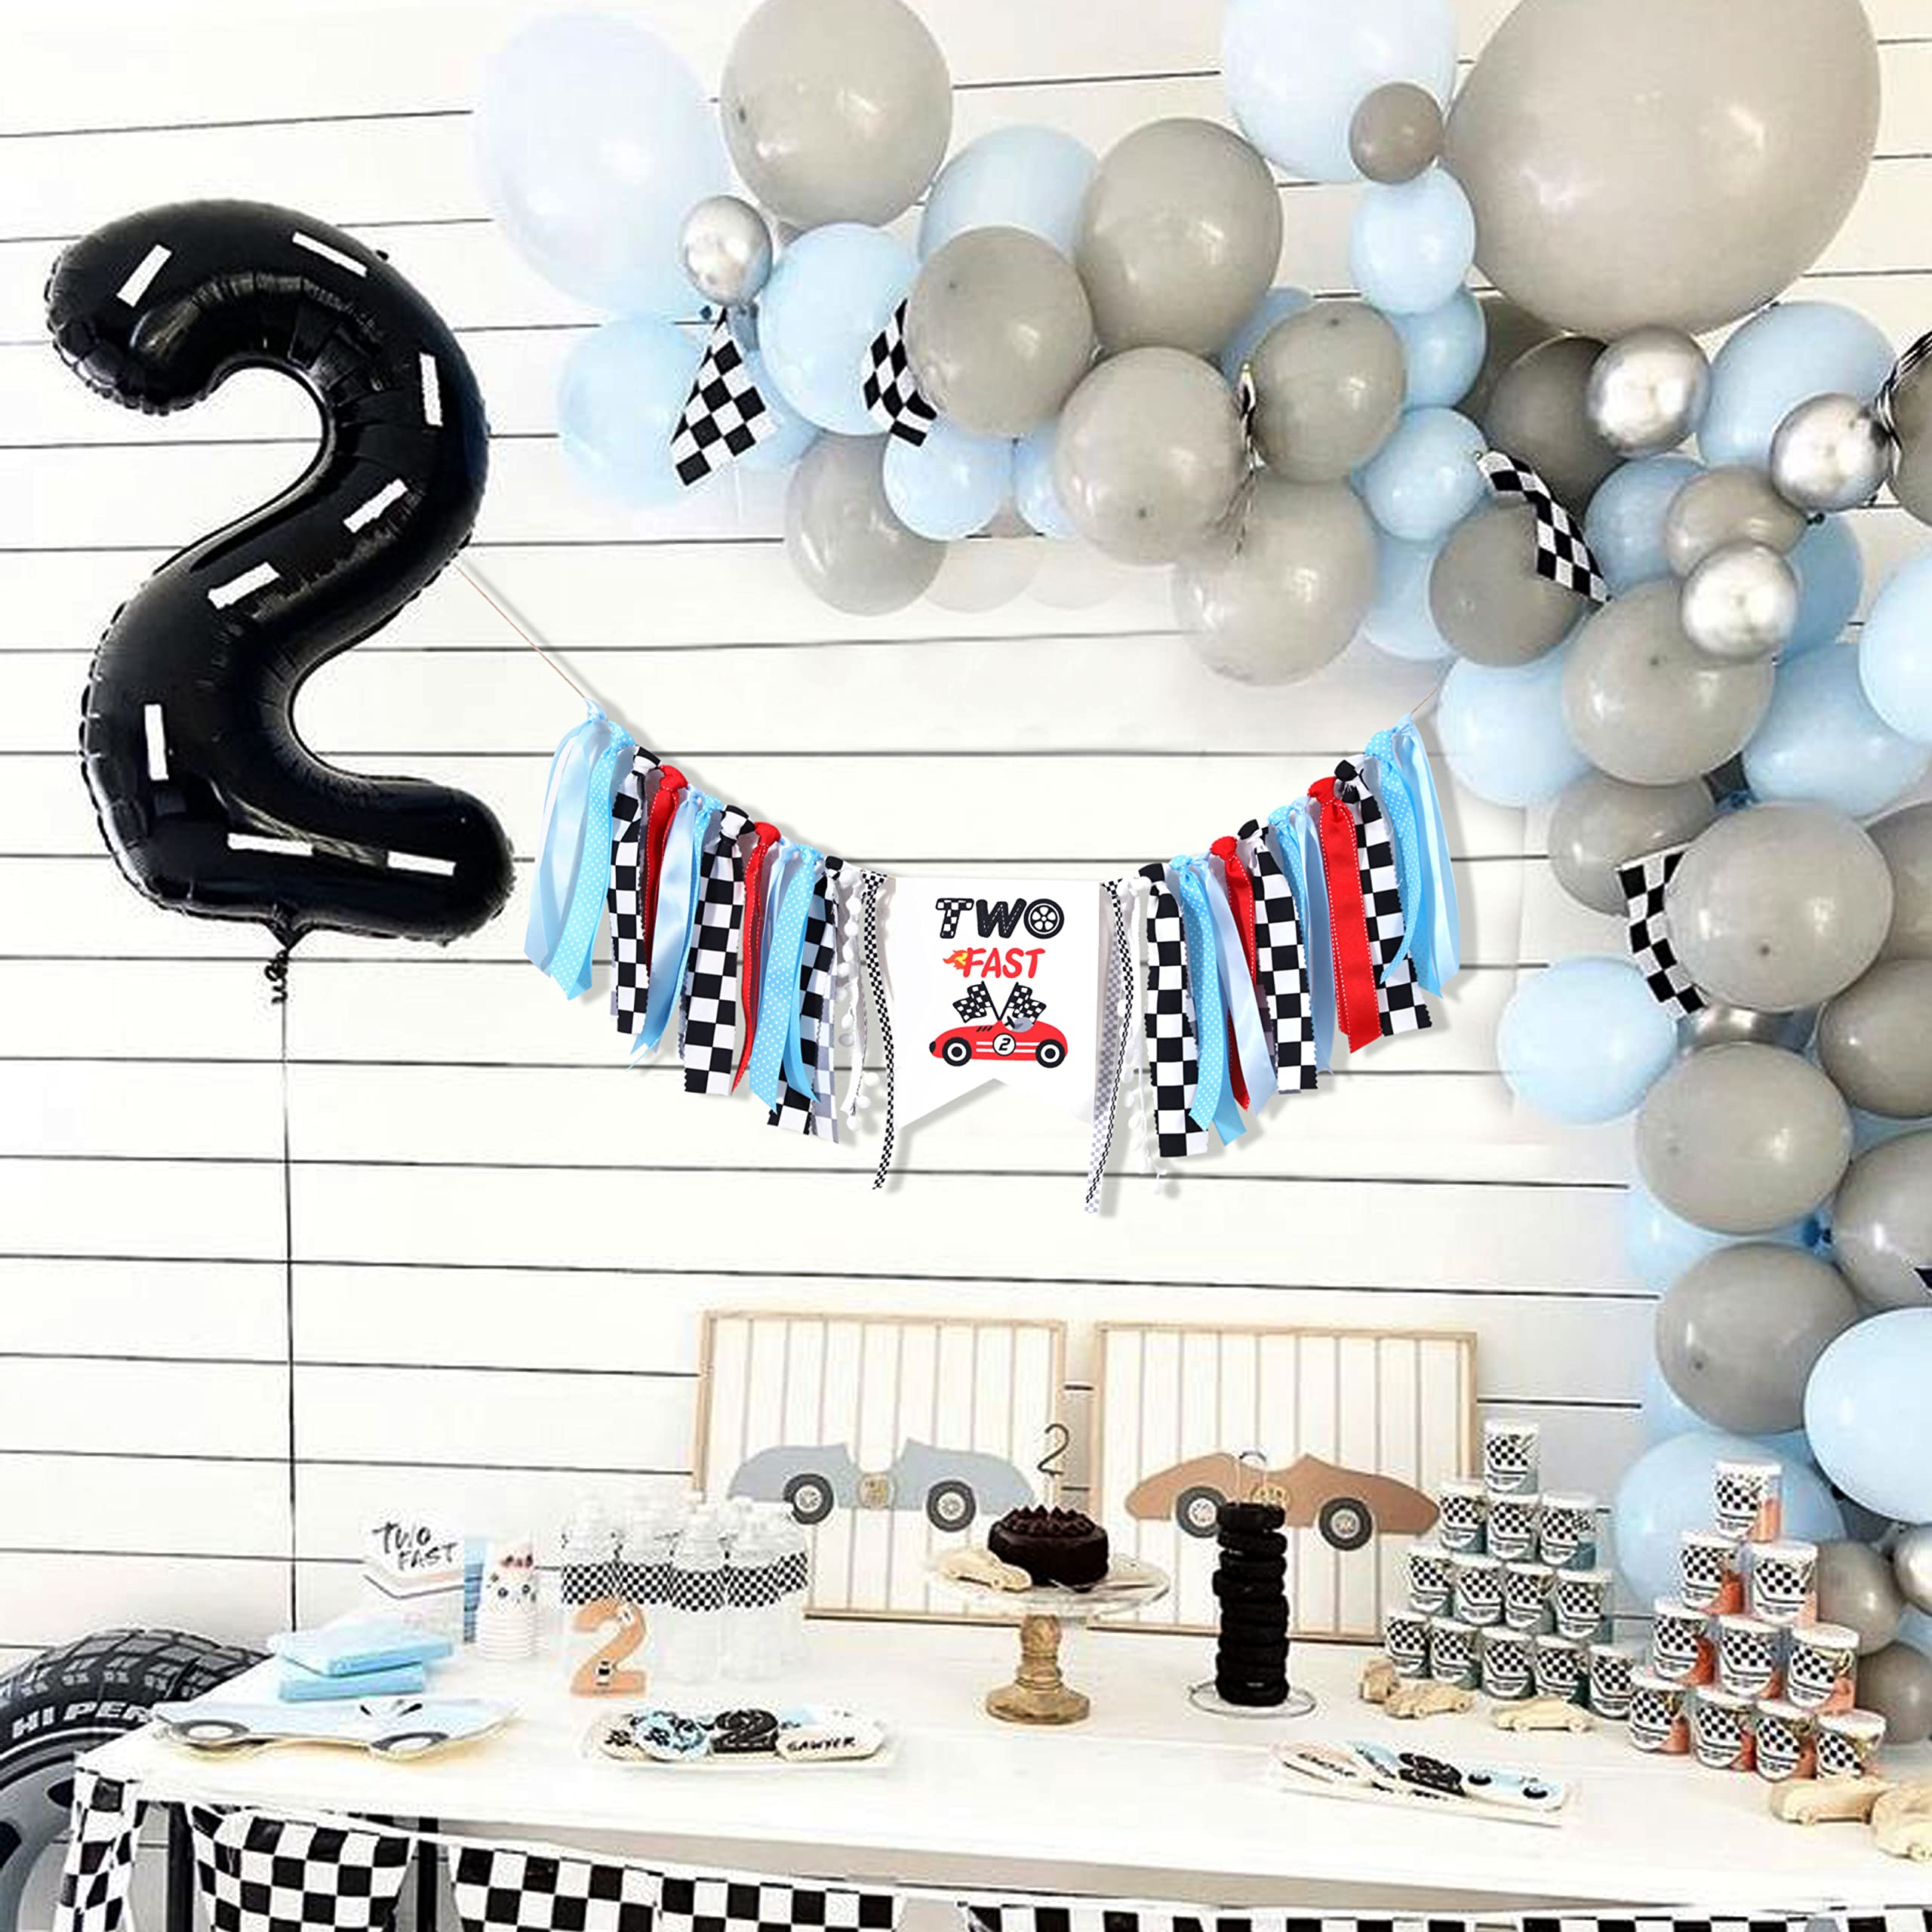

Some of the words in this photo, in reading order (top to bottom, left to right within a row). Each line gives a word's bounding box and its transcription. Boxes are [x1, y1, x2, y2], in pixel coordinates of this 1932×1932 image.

[45, 198, 515, 943] 2
[935, 897, 1065, 939] TWO
[962, 947, 1046, 979] FAST
[998, 1037, 1011, 1051] 2
[1037, 1423, 1069, 1477] 2
[372, 1521, 432, 1554] TWO
[398, 1542, 457, 1571] FAST
[569, 1598, 646, 1697] 2
[12, 1706, 54, 1739] HI
